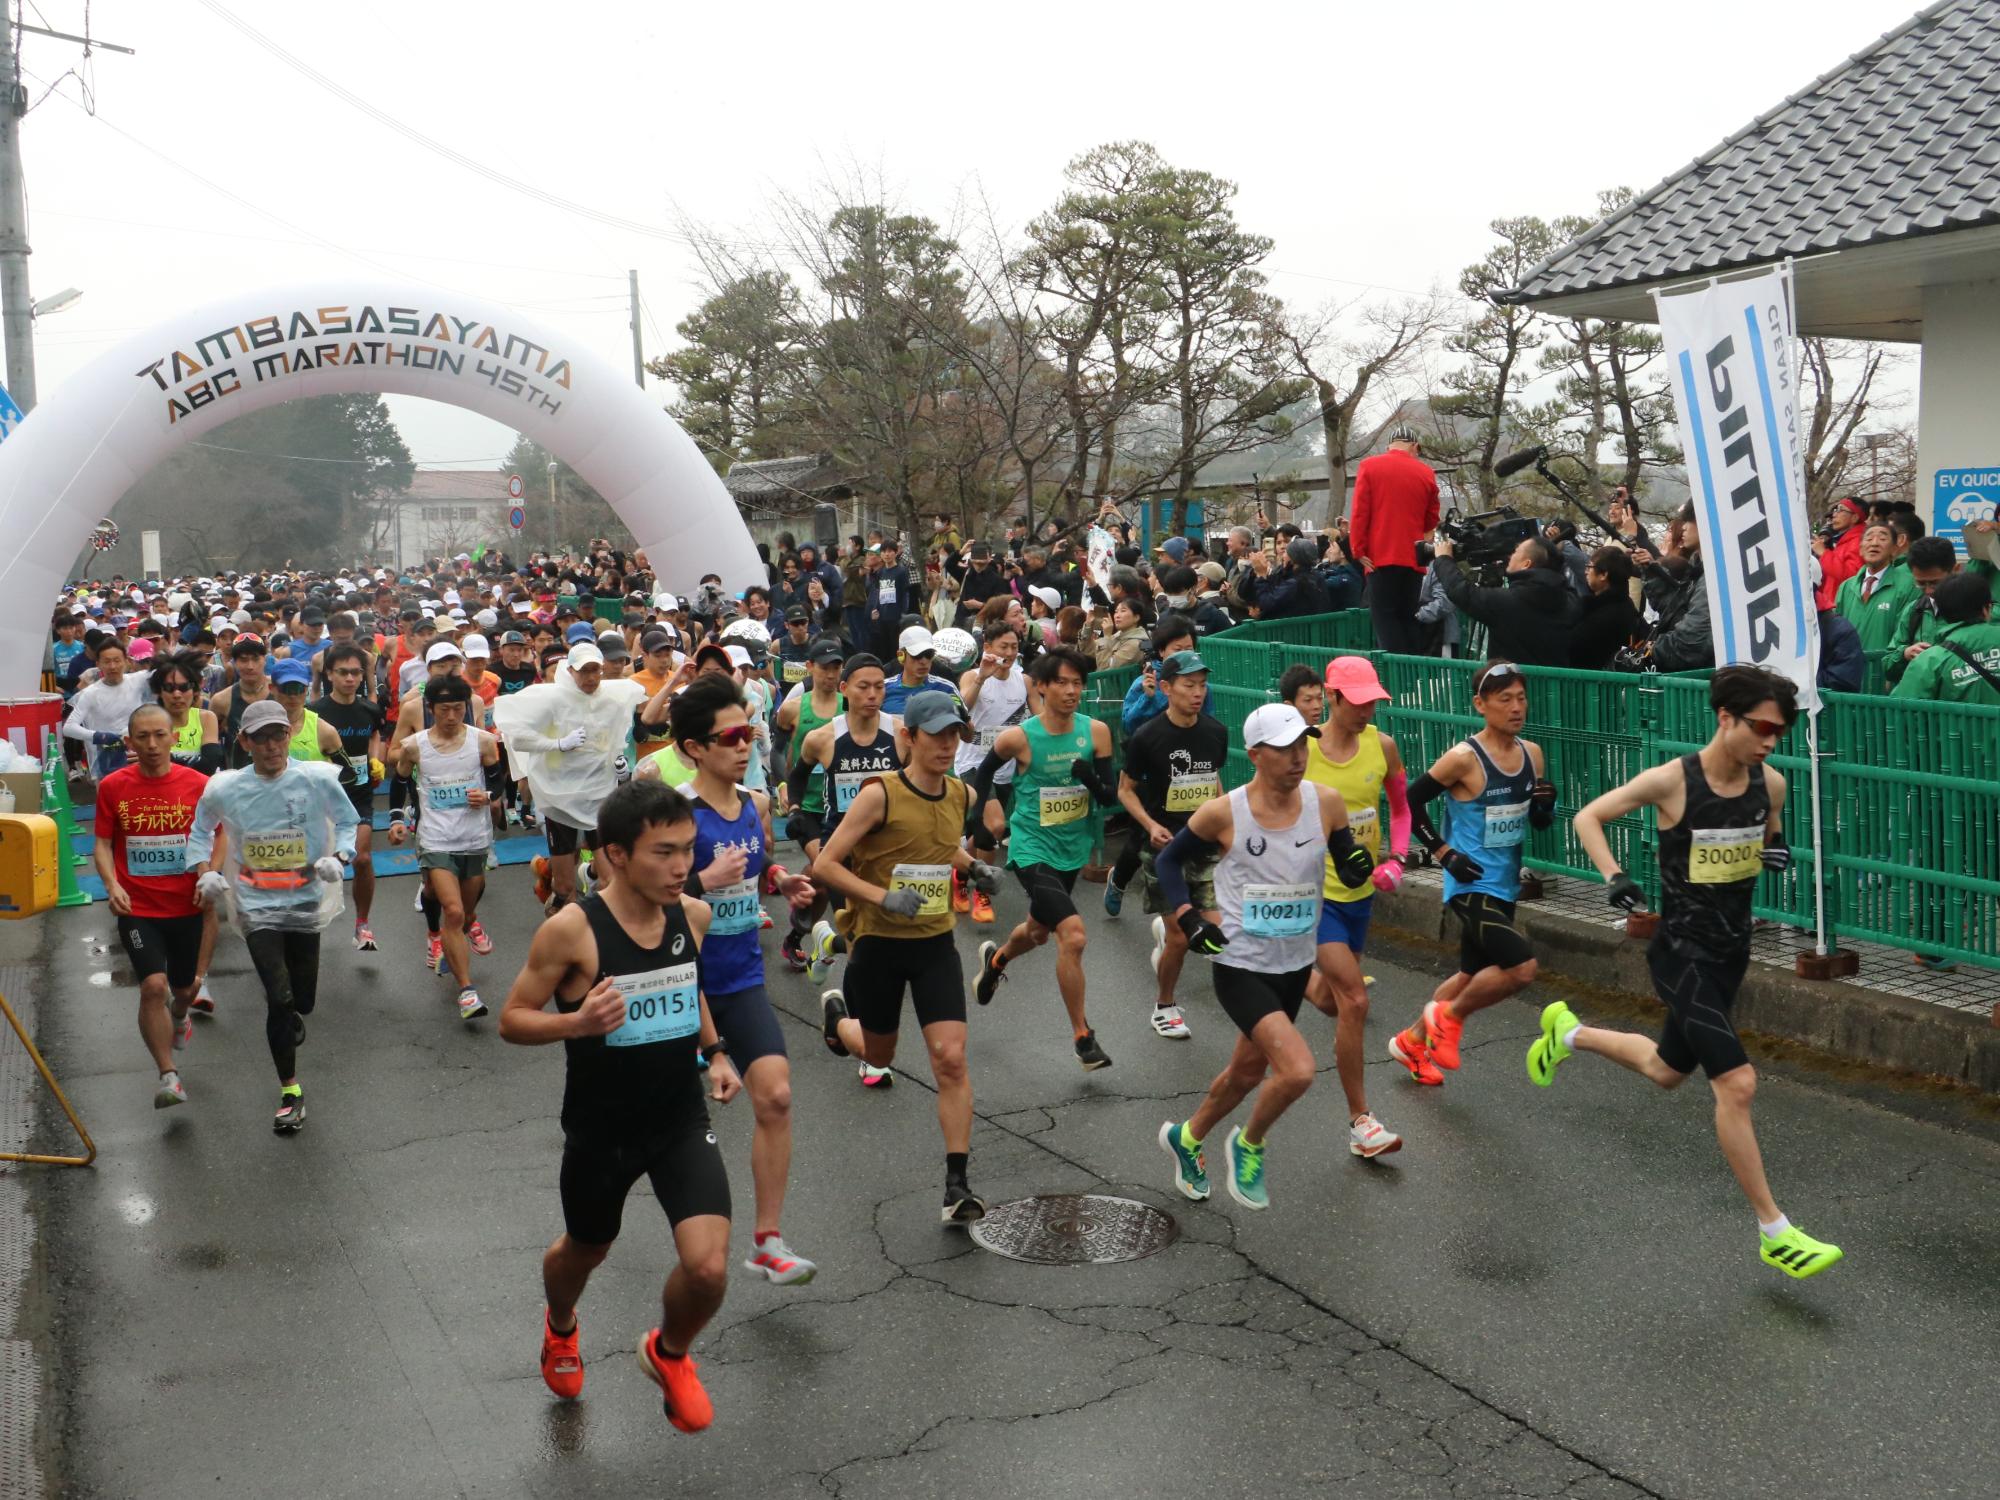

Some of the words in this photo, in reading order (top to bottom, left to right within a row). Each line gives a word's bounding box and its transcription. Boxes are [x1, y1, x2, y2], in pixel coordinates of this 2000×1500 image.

[135, 305, 571, 391] TAMBASASAYAMA
[169, 368, 241, 424] ABC
[252, 342, 465, 382] MARATHON
[475, 365, 563, 416] 45TH
[1940, 475, 1958, 487] EV
[1962, 473, 2000, 487] QUIC
[1192, 761, 1212, 769] 2025
[1171, 786, 1209, 800] 30094
[131, 850, 176, 863] 10033
[248, 844, 294, 858] 30264
[1697, 846, 1751, 864] 30020
[1250, 903, 1302, 920] 10021
[666, 971, 695, 985] PILLAR
[629, 992, 684, 1021] 0015
[689, 996, 696, 1012] A
